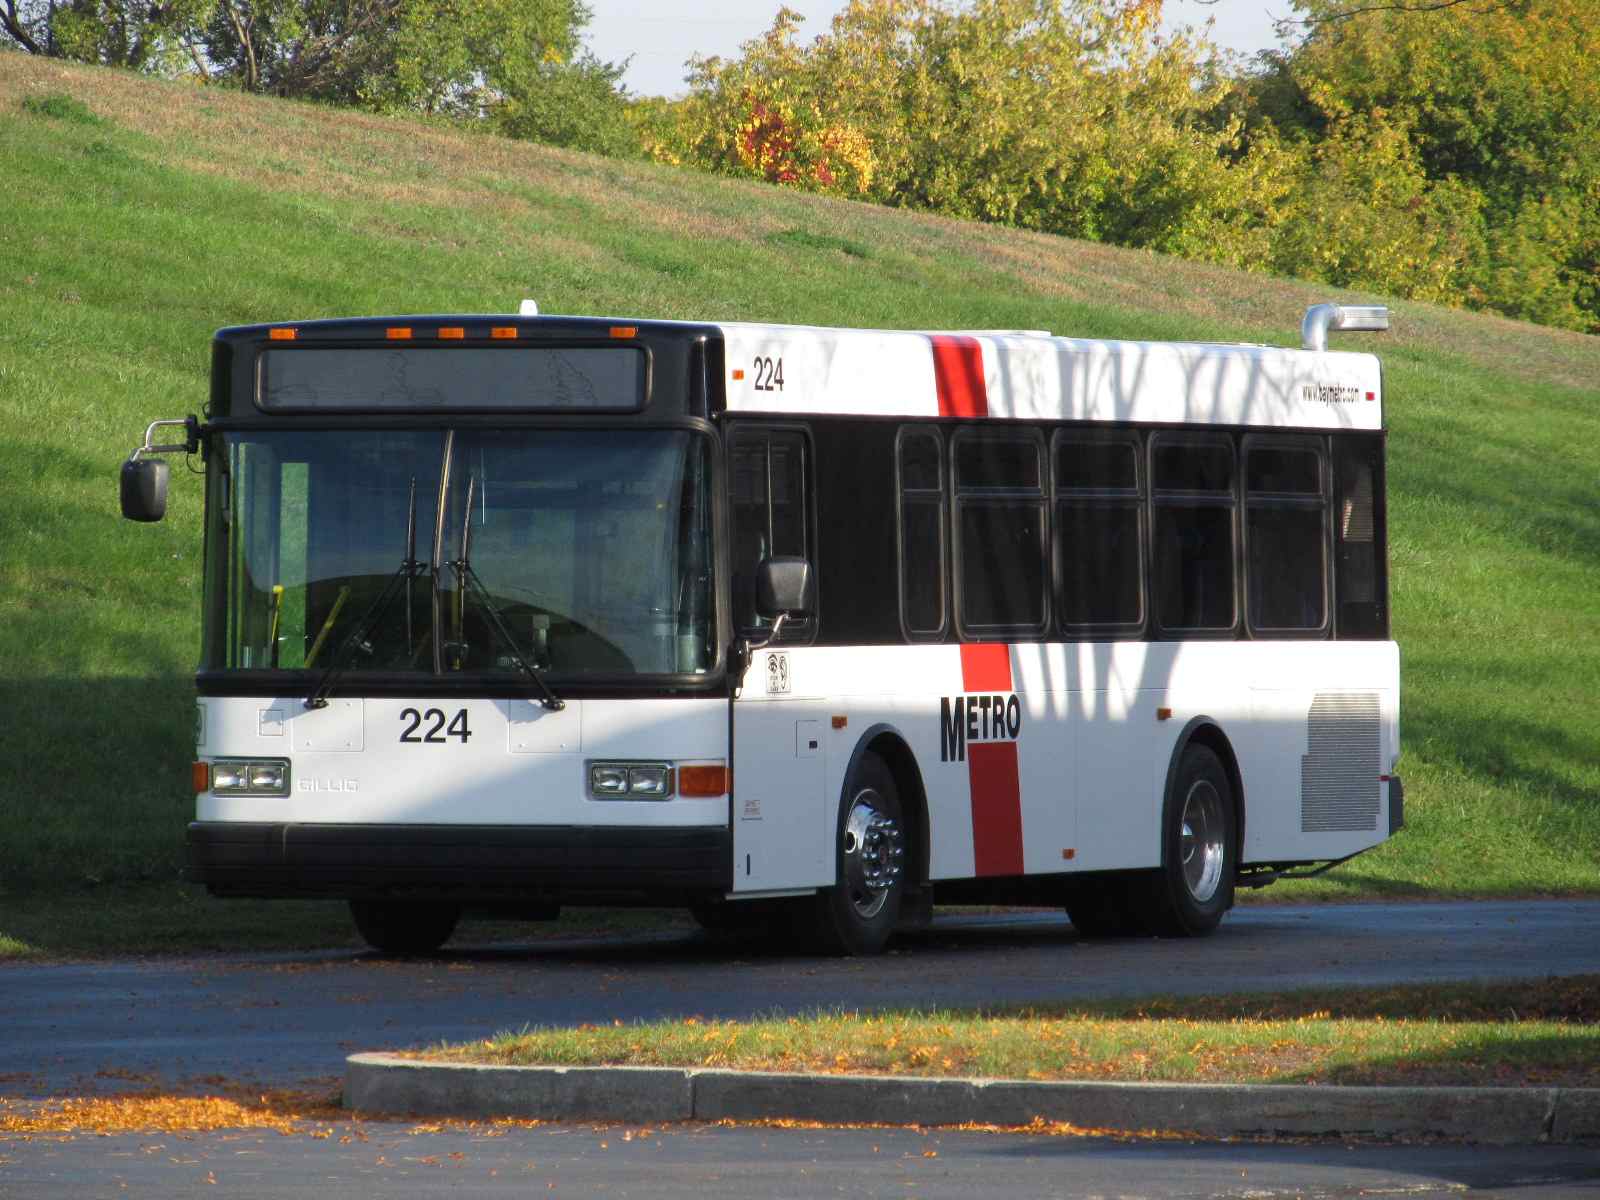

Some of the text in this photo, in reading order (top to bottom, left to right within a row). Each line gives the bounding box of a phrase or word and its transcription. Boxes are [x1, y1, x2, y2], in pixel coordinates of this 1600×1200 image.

[754, 356, 784, 392] 224
[1302, 383, 1359, 407] www.baymetro.com
[400, 708, 472, 743] 224
[940, 694, 1021, 762] METRO
[298, 778, 360, 793] GILLIG
